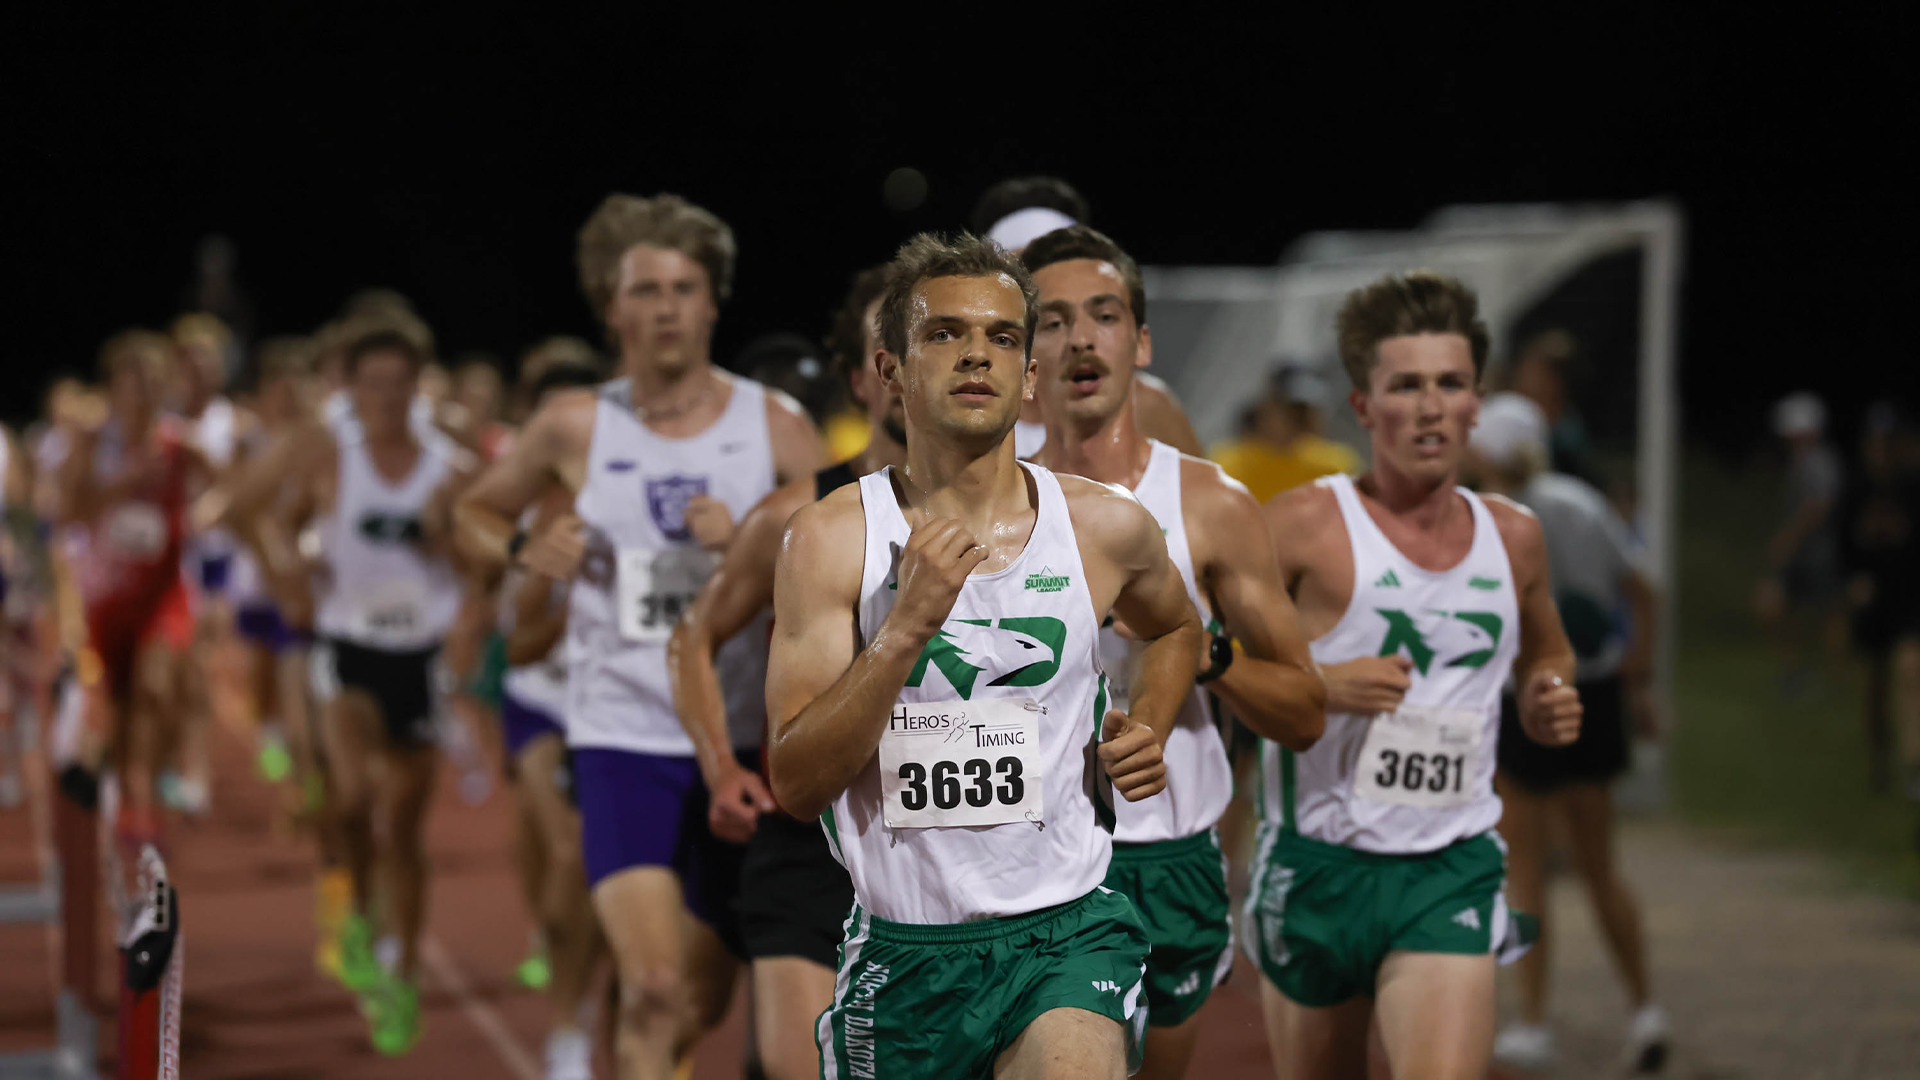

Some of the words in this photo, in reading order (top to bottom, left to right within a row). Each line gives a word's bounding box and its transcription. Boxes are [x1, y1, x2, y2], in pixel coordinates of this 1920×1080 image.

[1025, 576, 1070, 590] SUMMIT
[890, 706, 950, 731] HERO'S
[969, 724, 1025, 748] TIMING
[898, 756, 1024, 811] 3633
[1375, 749, 1465, 793] 3631
[844, 1013, 876, 1079] DAKOTA
